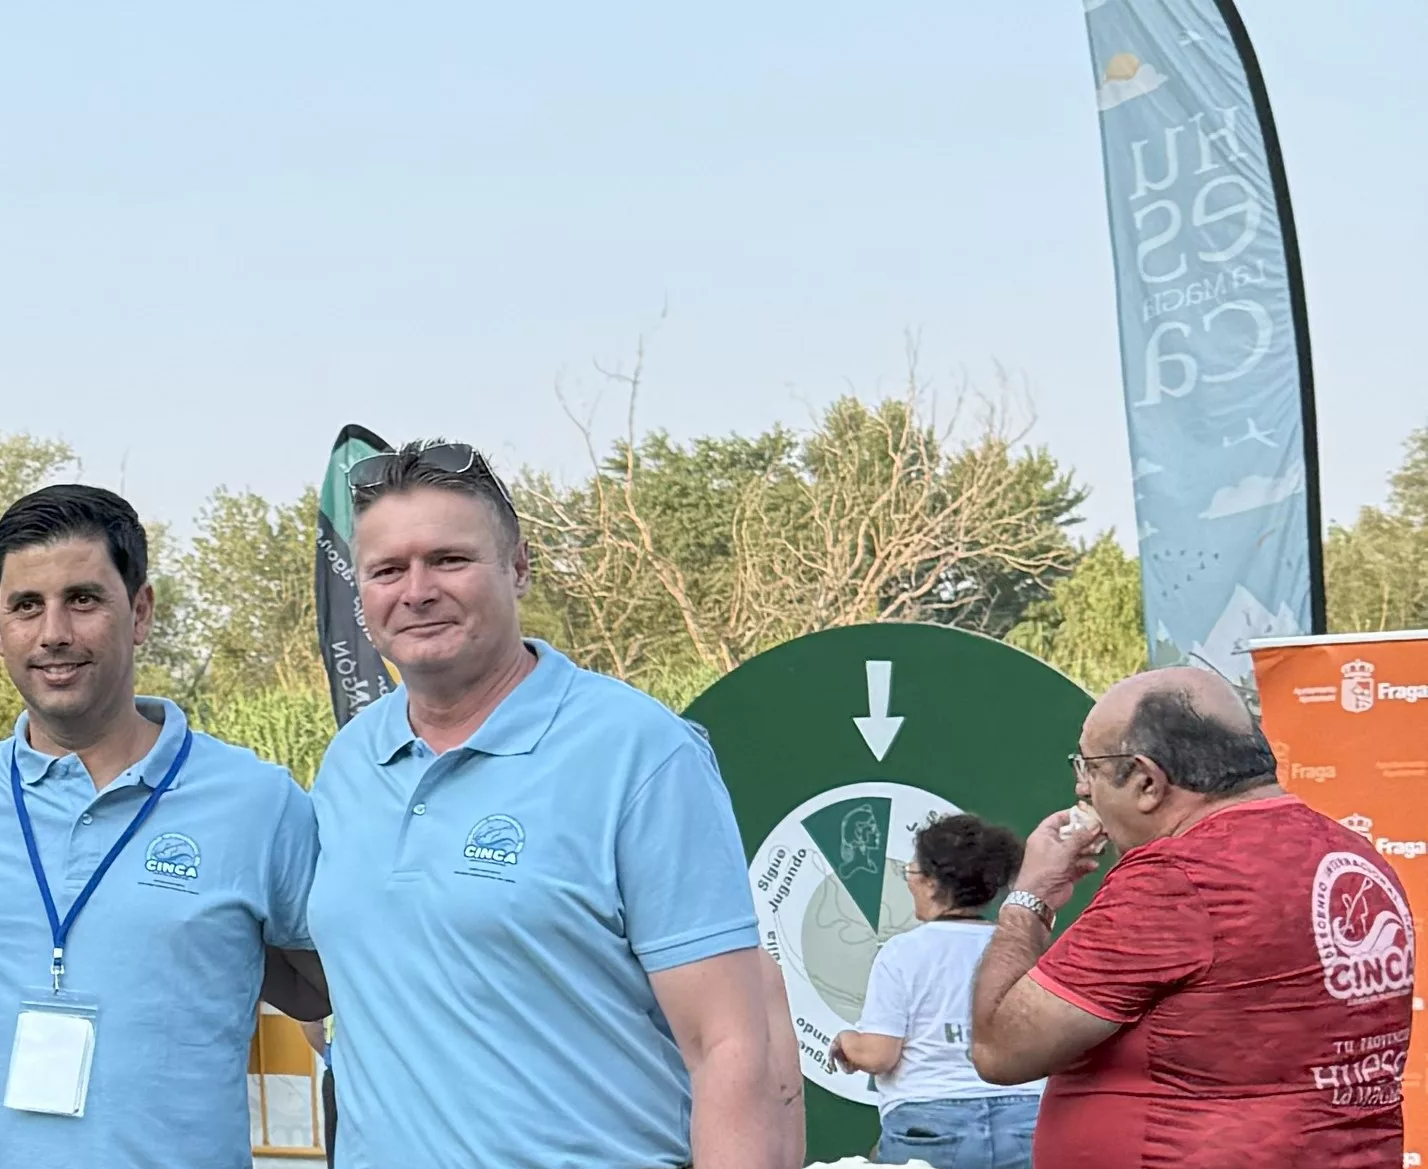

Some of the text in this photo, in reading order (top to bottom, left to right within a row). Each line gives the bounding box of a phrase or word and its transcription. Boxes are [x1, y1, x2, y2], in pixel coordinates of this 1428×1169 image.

[145, 859, 198, 879] CINCA
[464, 844, 517, 865] CINCA
[757, 849, 786, 892] Sigue
[768, 848, 807, 914] Jugando
